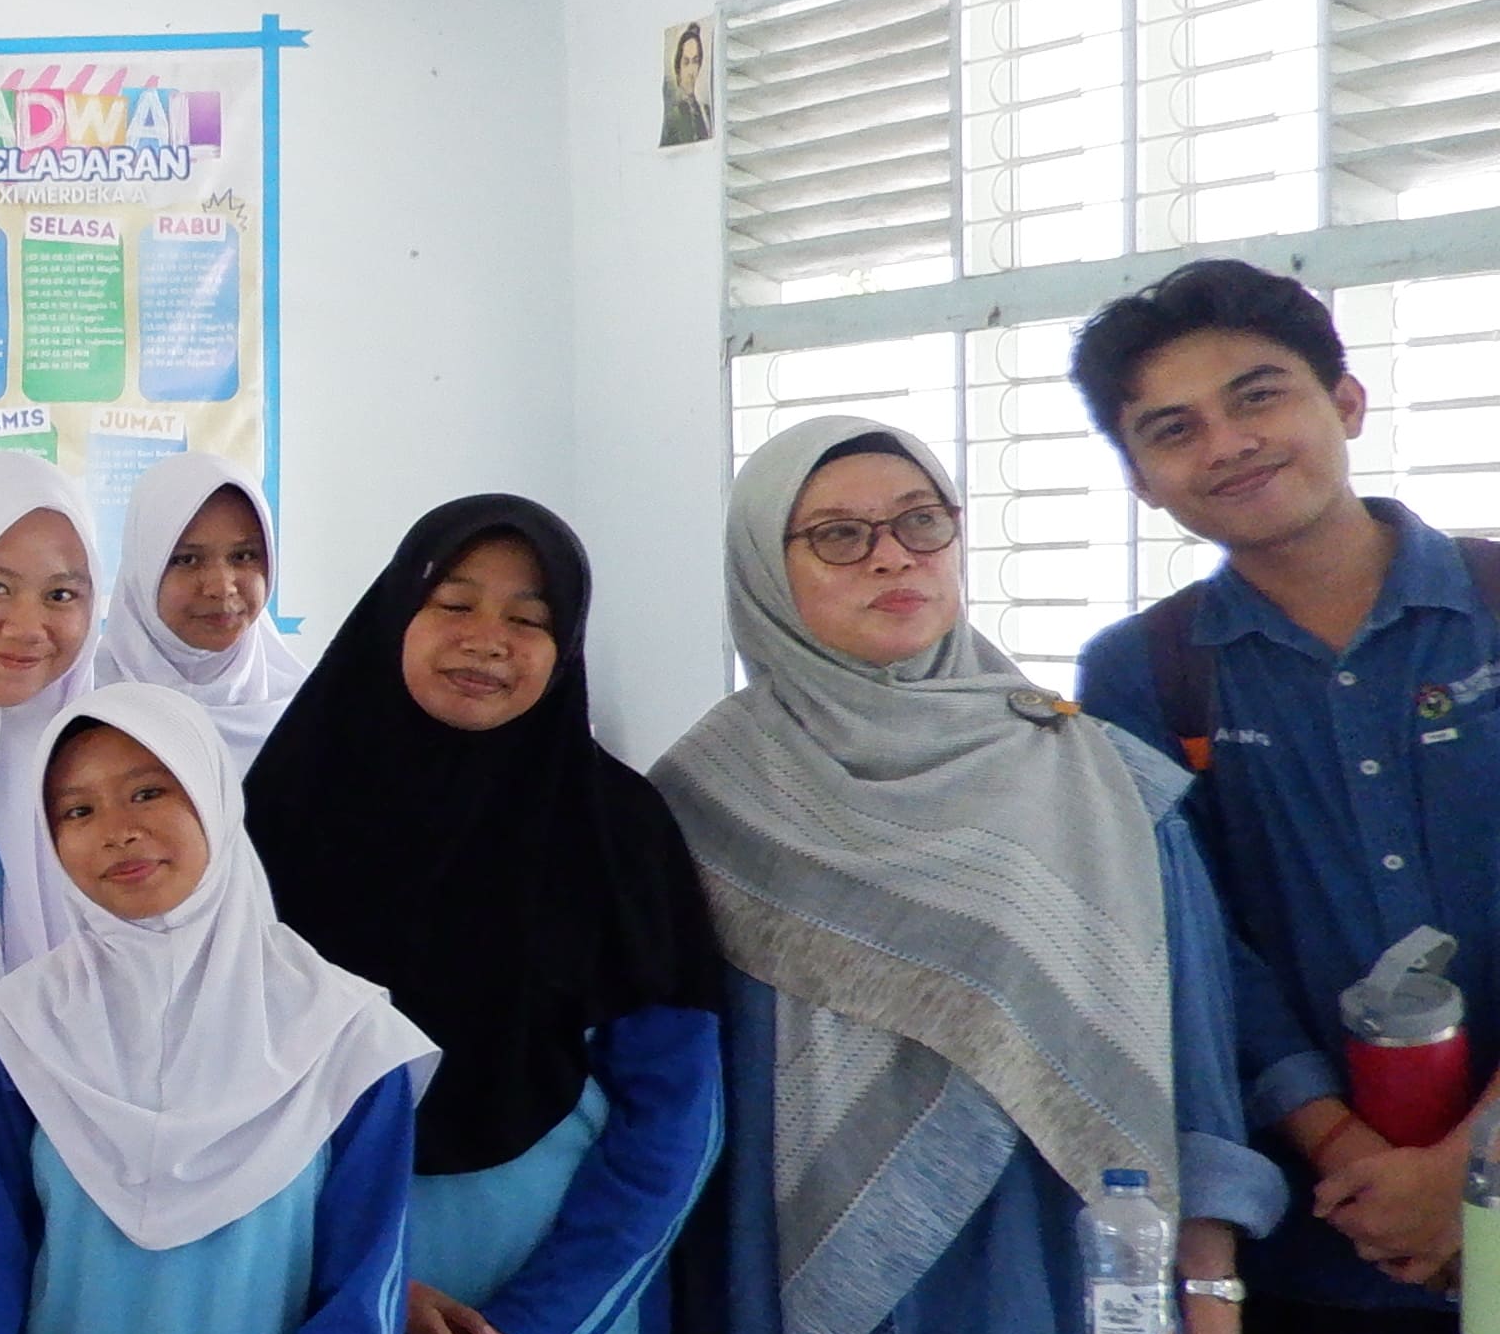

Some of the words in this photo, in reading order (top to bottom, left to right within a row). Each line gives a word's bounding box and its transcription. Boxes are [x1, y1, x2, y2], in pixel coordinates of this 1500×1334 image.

[0, 185, 20, 204] XI
[26, 184, 127, 204] MERDEKA
[132, 183, 147, 203] A
[30, 215, 116, 239] SELASA
[158, 215, 222, 236] RABU
[99, 410, 177, 433] JUMAT
